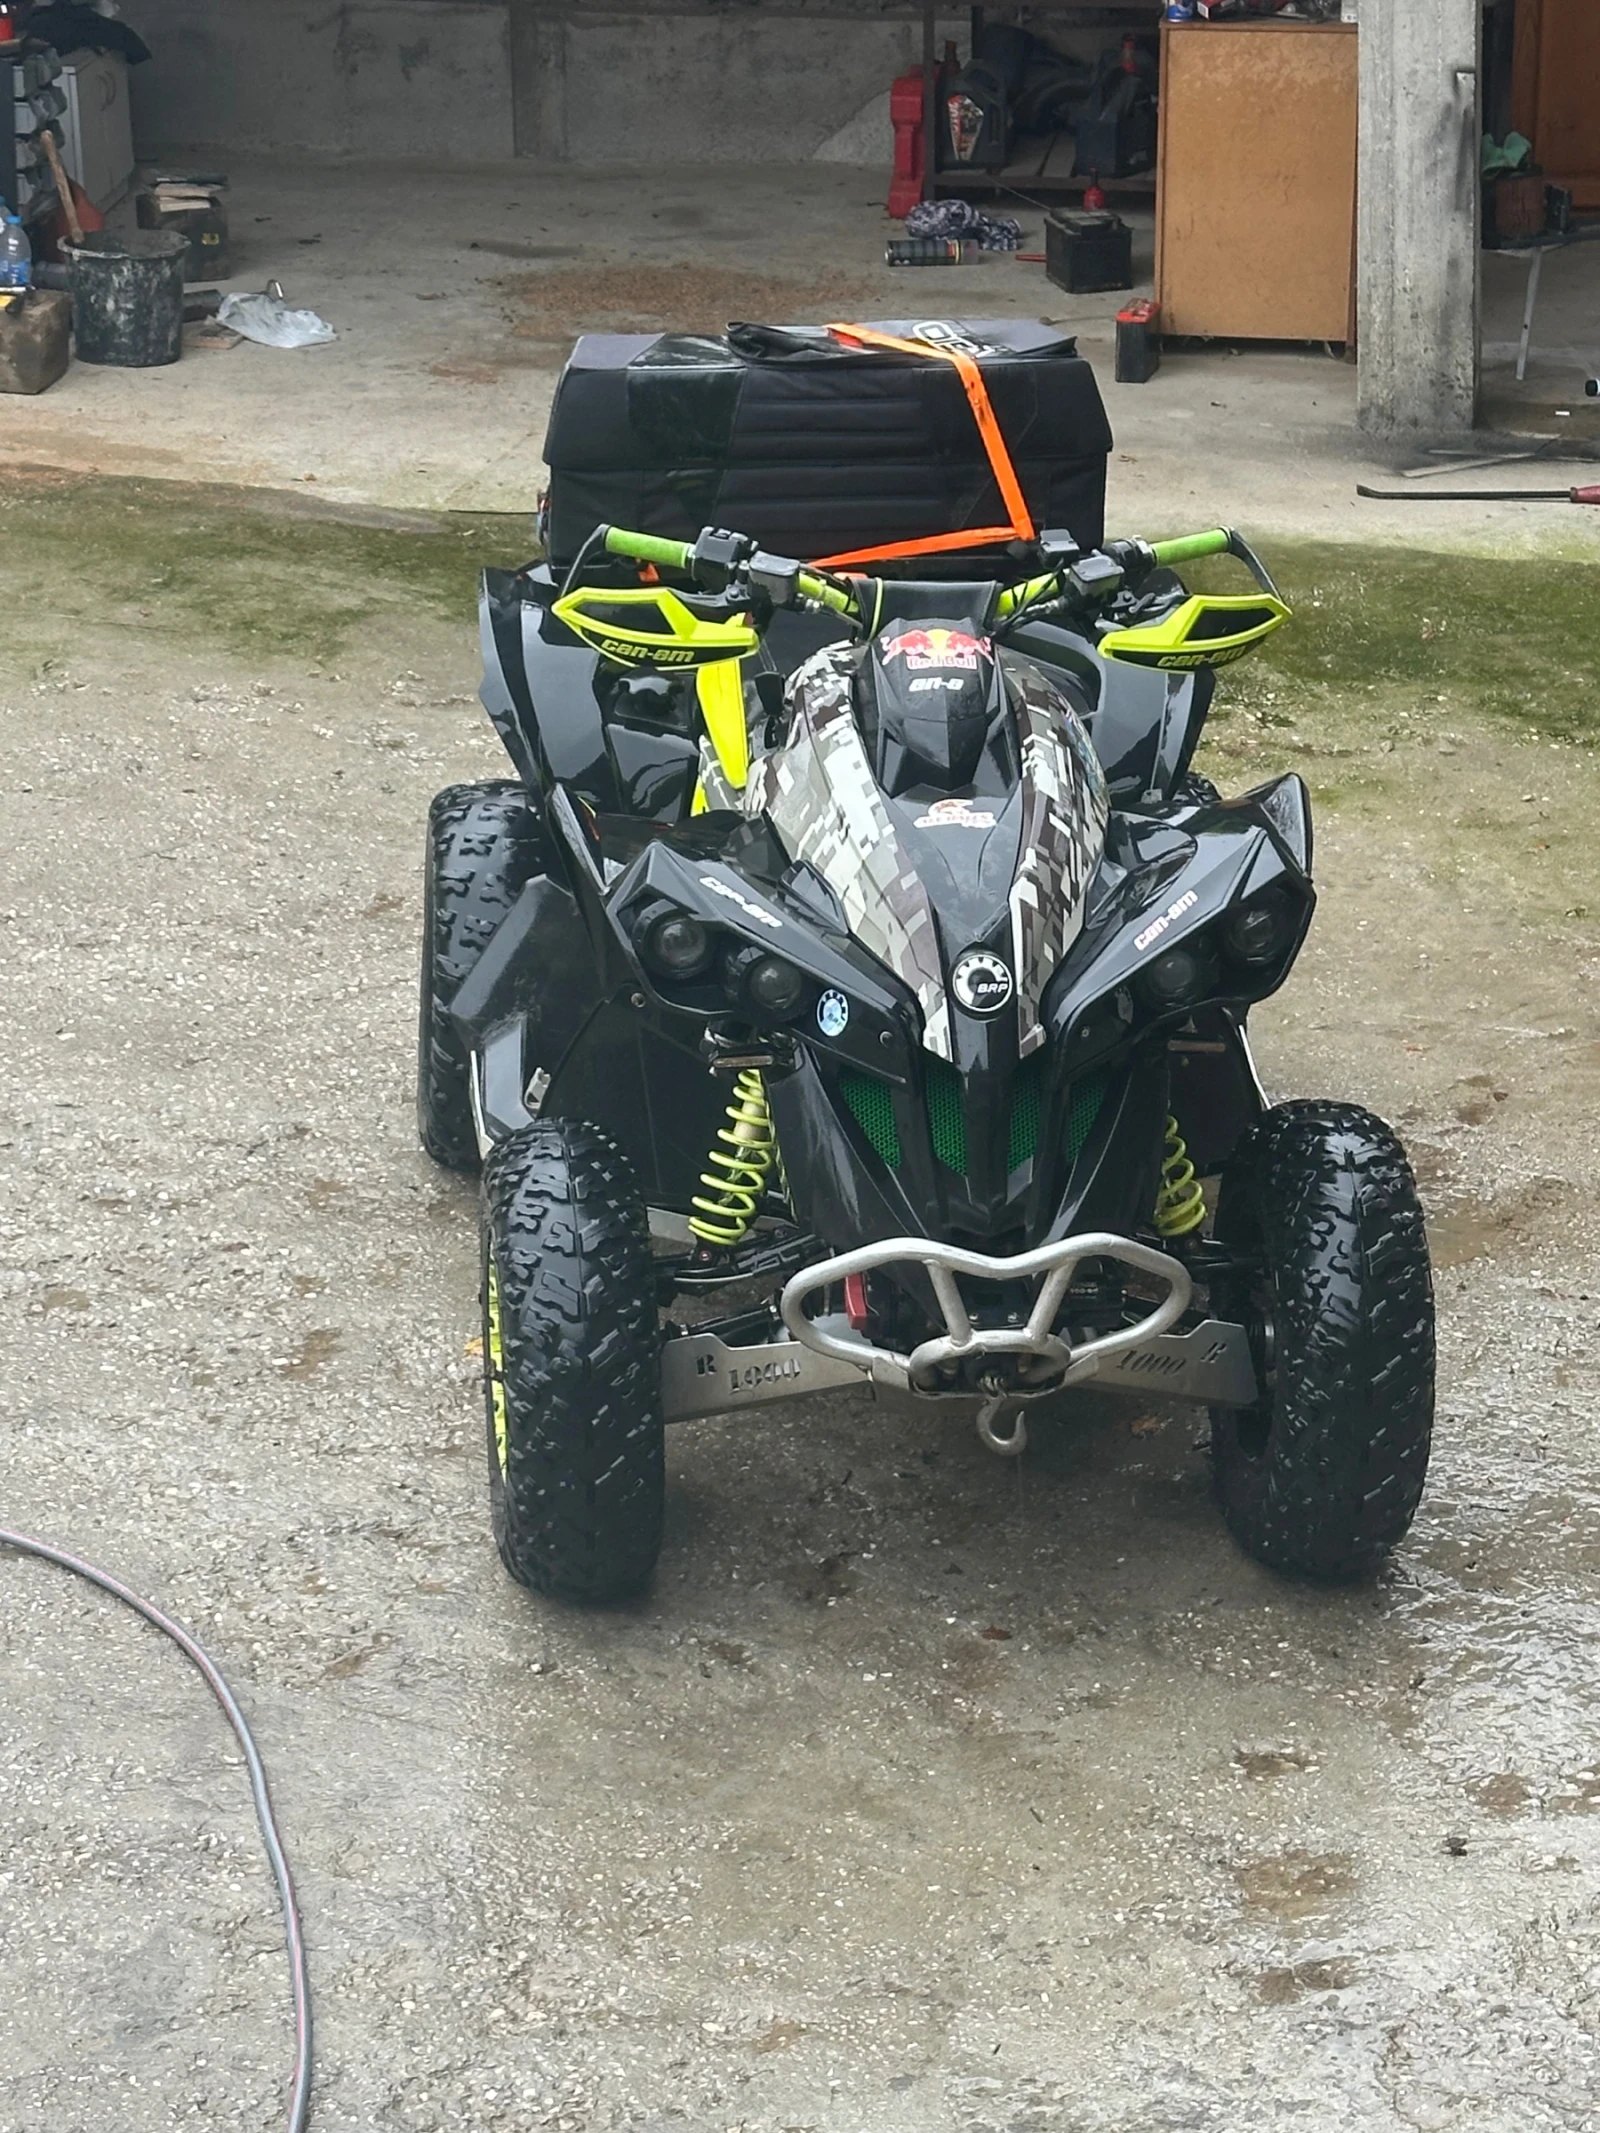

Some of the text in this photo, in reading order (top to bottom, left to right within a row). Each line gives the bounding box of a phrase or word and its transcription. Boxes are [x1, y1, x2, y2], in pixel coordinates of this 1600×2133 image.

[601, 638, 695, 663] can-am
[1157, 646, 1246, 667] can-am
[1133, 890, 1199, 951] can-am
[977, 982, 1009, 993] BRP
[696, 1354, 717, 1377] R
